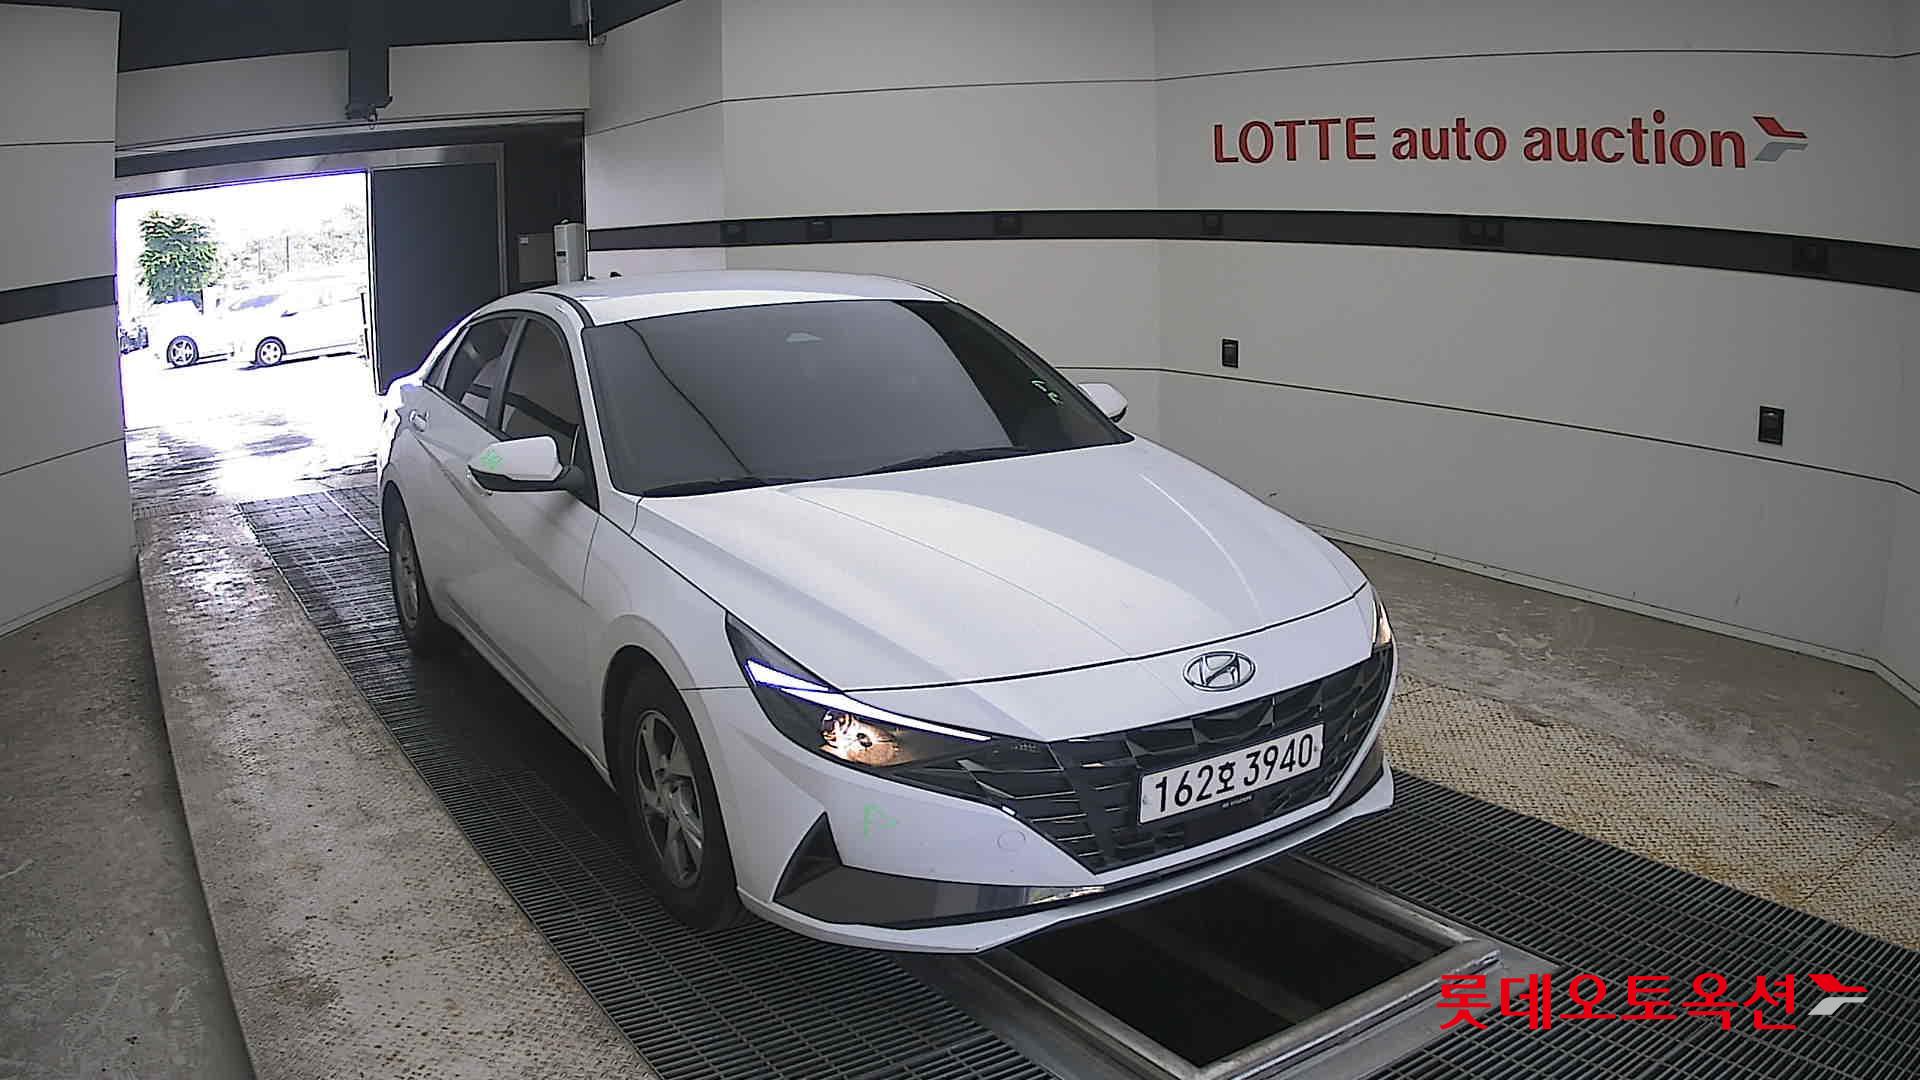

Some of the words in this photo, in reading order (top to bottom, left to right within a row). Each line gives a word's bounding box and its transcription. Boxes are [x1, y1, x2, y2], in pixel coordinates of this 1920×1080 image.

[1213, 116, 1376, 164] LOTTE
[1391, 117, 1507, 162] auto
[1523, 109, 1747, 169] auction
[1155, 761, 1236, 813] 162호
[1243, 733, 1314, 787] 3940
